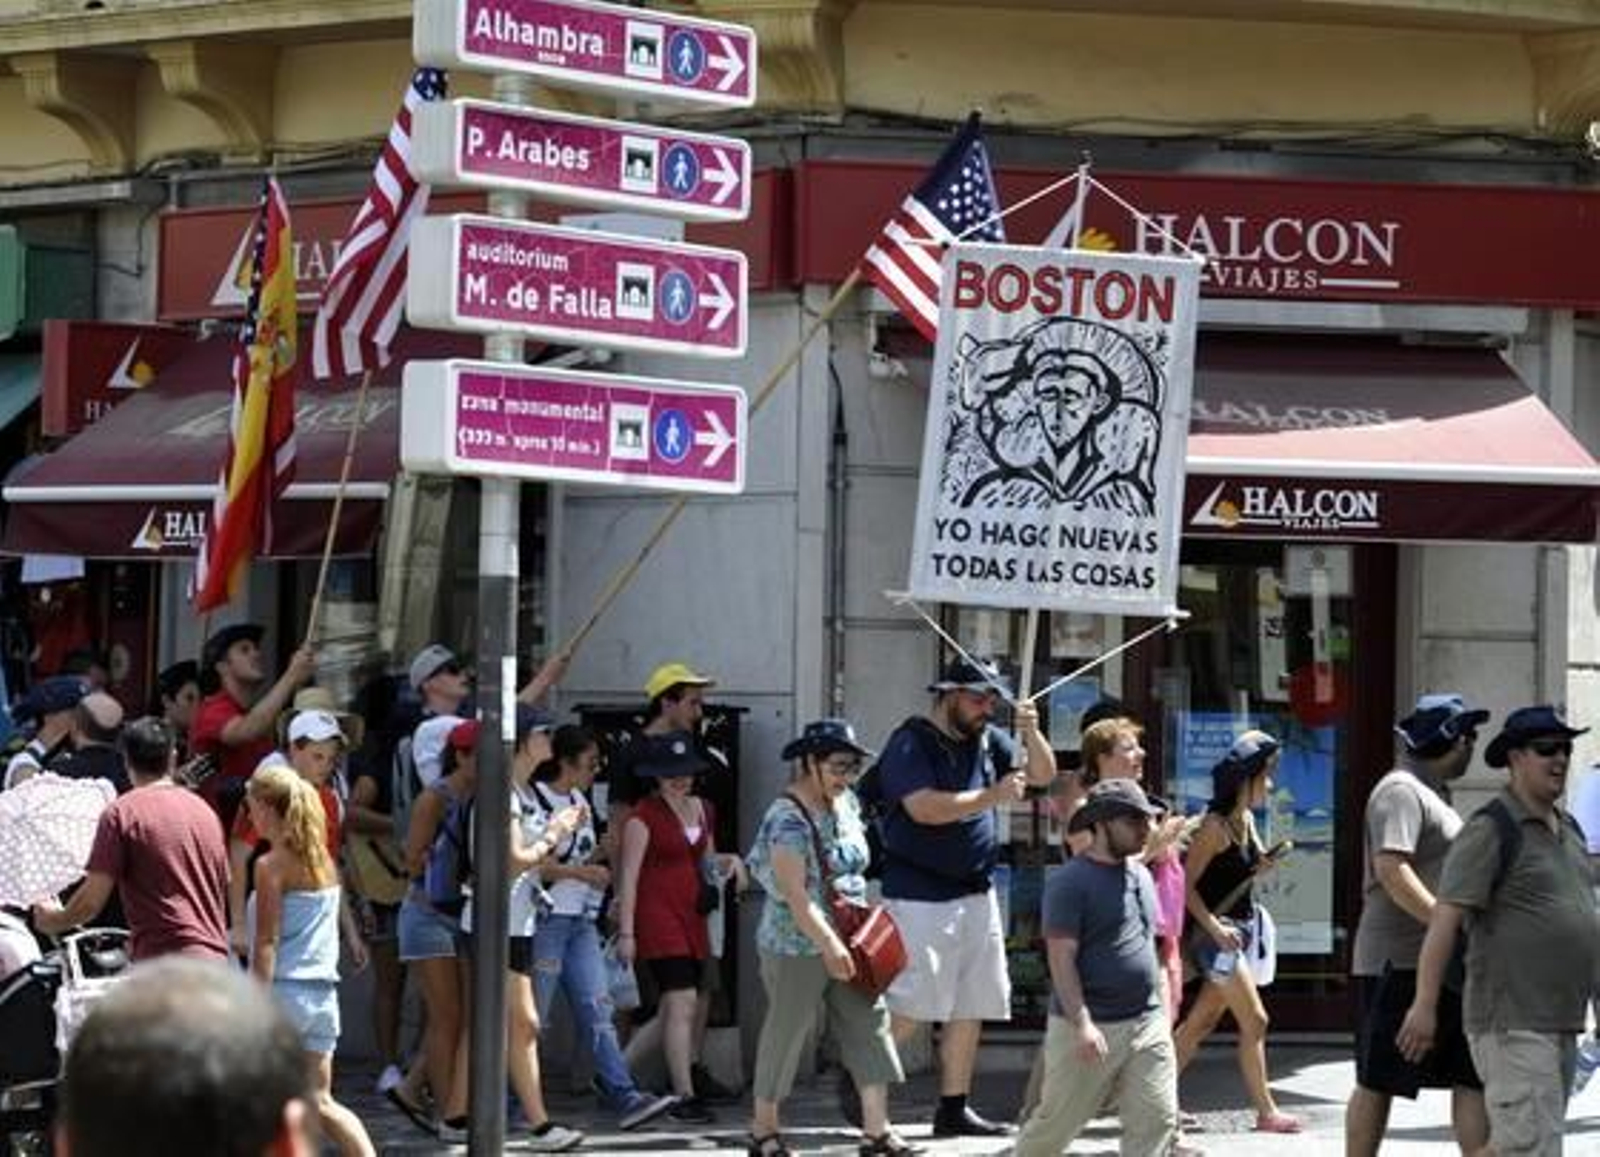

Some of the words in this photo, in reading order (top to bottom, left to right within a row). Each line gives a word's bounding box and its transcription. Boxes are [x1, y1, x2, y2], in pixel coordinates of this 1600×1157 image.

[472, 8, 604, 56] Alhambra
[467, 125, 492, 157] P.
[499, 131, 590, 170] Arabes
[467, 242, 568, 272] auditorium
[1132, 213, 1399, 267] HALCON
[953, 260, 1176, 323] BOSTON
[1213, 263, 1319, 292] VIAJES
[465, 273, 497, 306] M.
[507, 281, 538, 311] de
[549, 285, 612, 319] Falla
[504, 400, 604, 422] monumental
[1242, 486, 1378, 518] HALCON
[934, 518, 972, 542] YO
[1059, 525, 1158, 554] NUEVAS
[932, 554, 1017, 580] TODAS
[1026, 560, 1064, 583] LAS
[1072, 562, 1156, 589] COSAS
